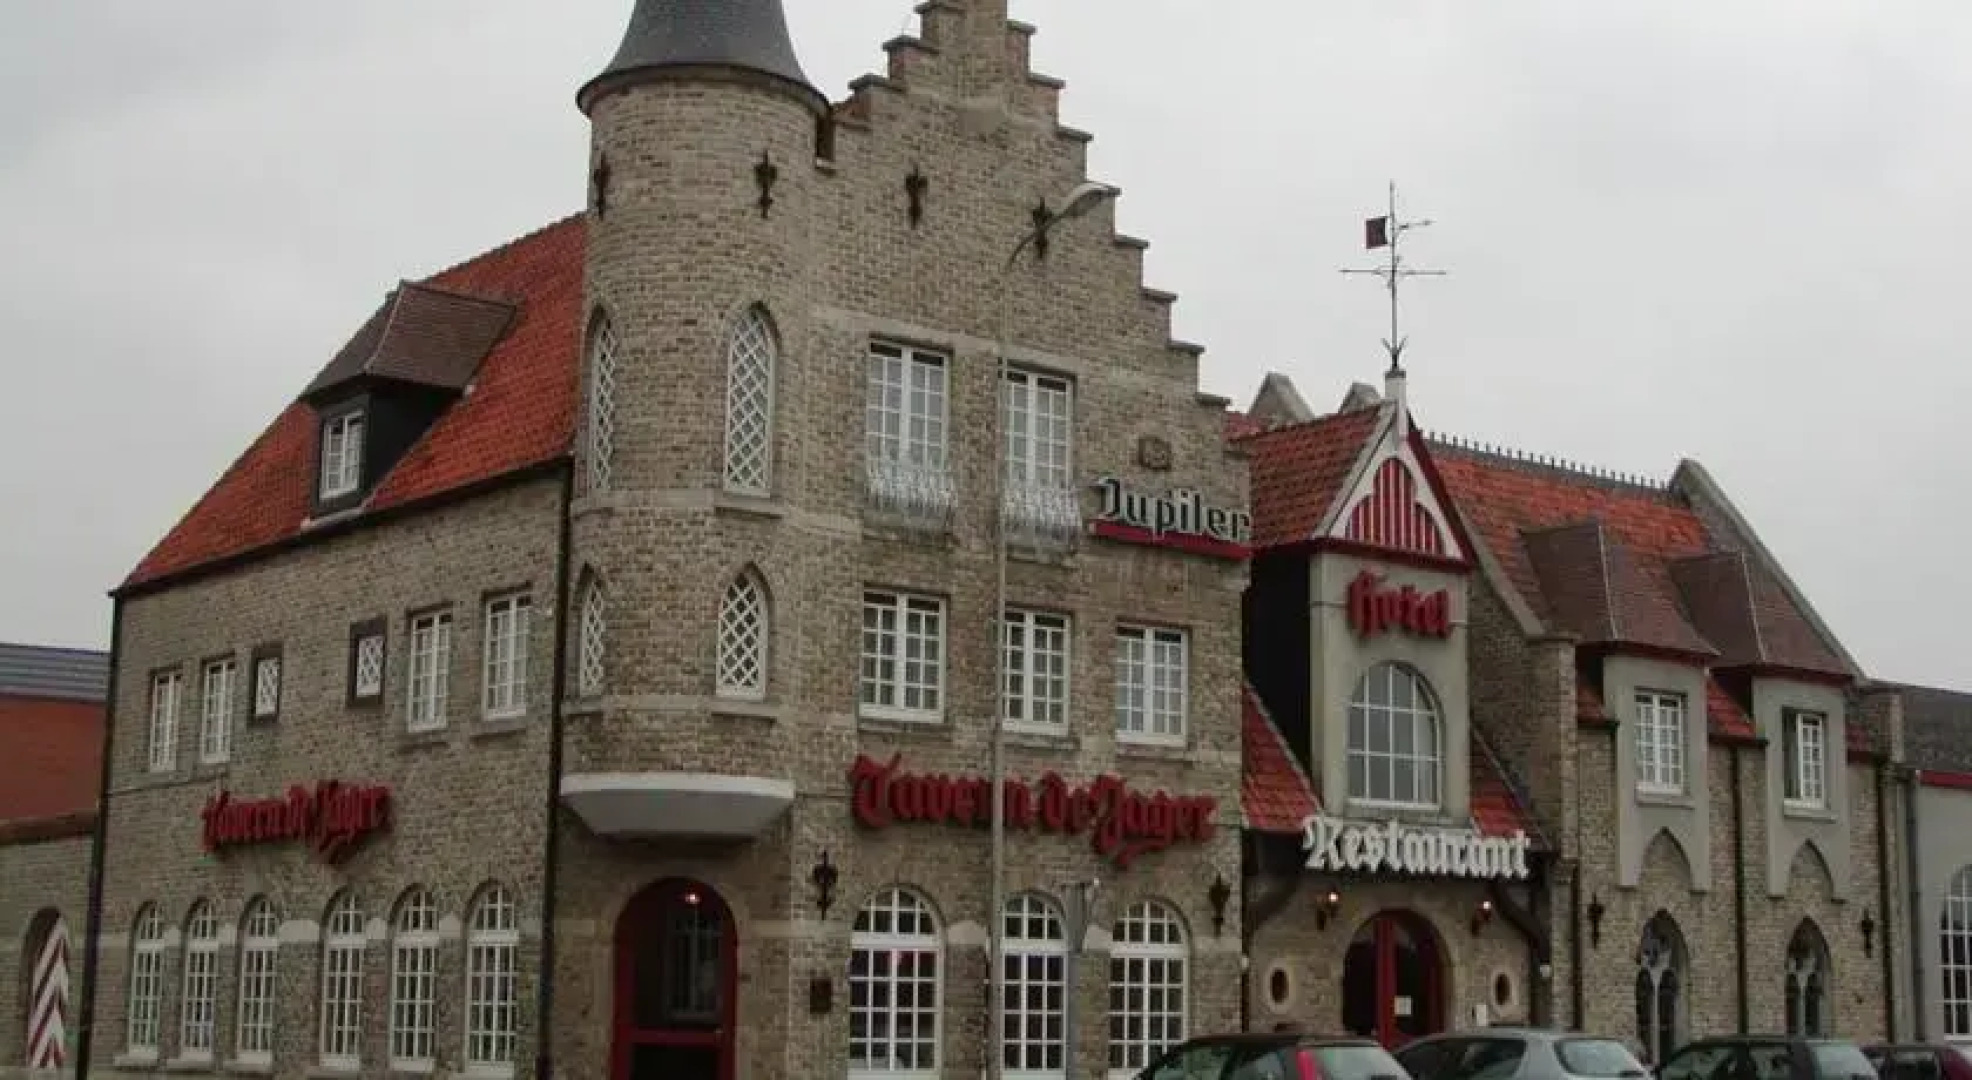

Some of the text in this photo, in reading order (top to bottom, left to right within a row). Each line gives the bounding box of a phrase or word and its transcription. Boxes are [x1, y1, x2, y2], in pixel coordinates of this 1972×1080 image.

[1090, 478, 1250, 541] Jupiler
[1346, 569, 1452, 638] Hotel
[201, 790, 288, 853] Tavern
[847, 752, 1217, 866] Tavern de Jager
[1302, 813, 1531, 879] Restaurant
